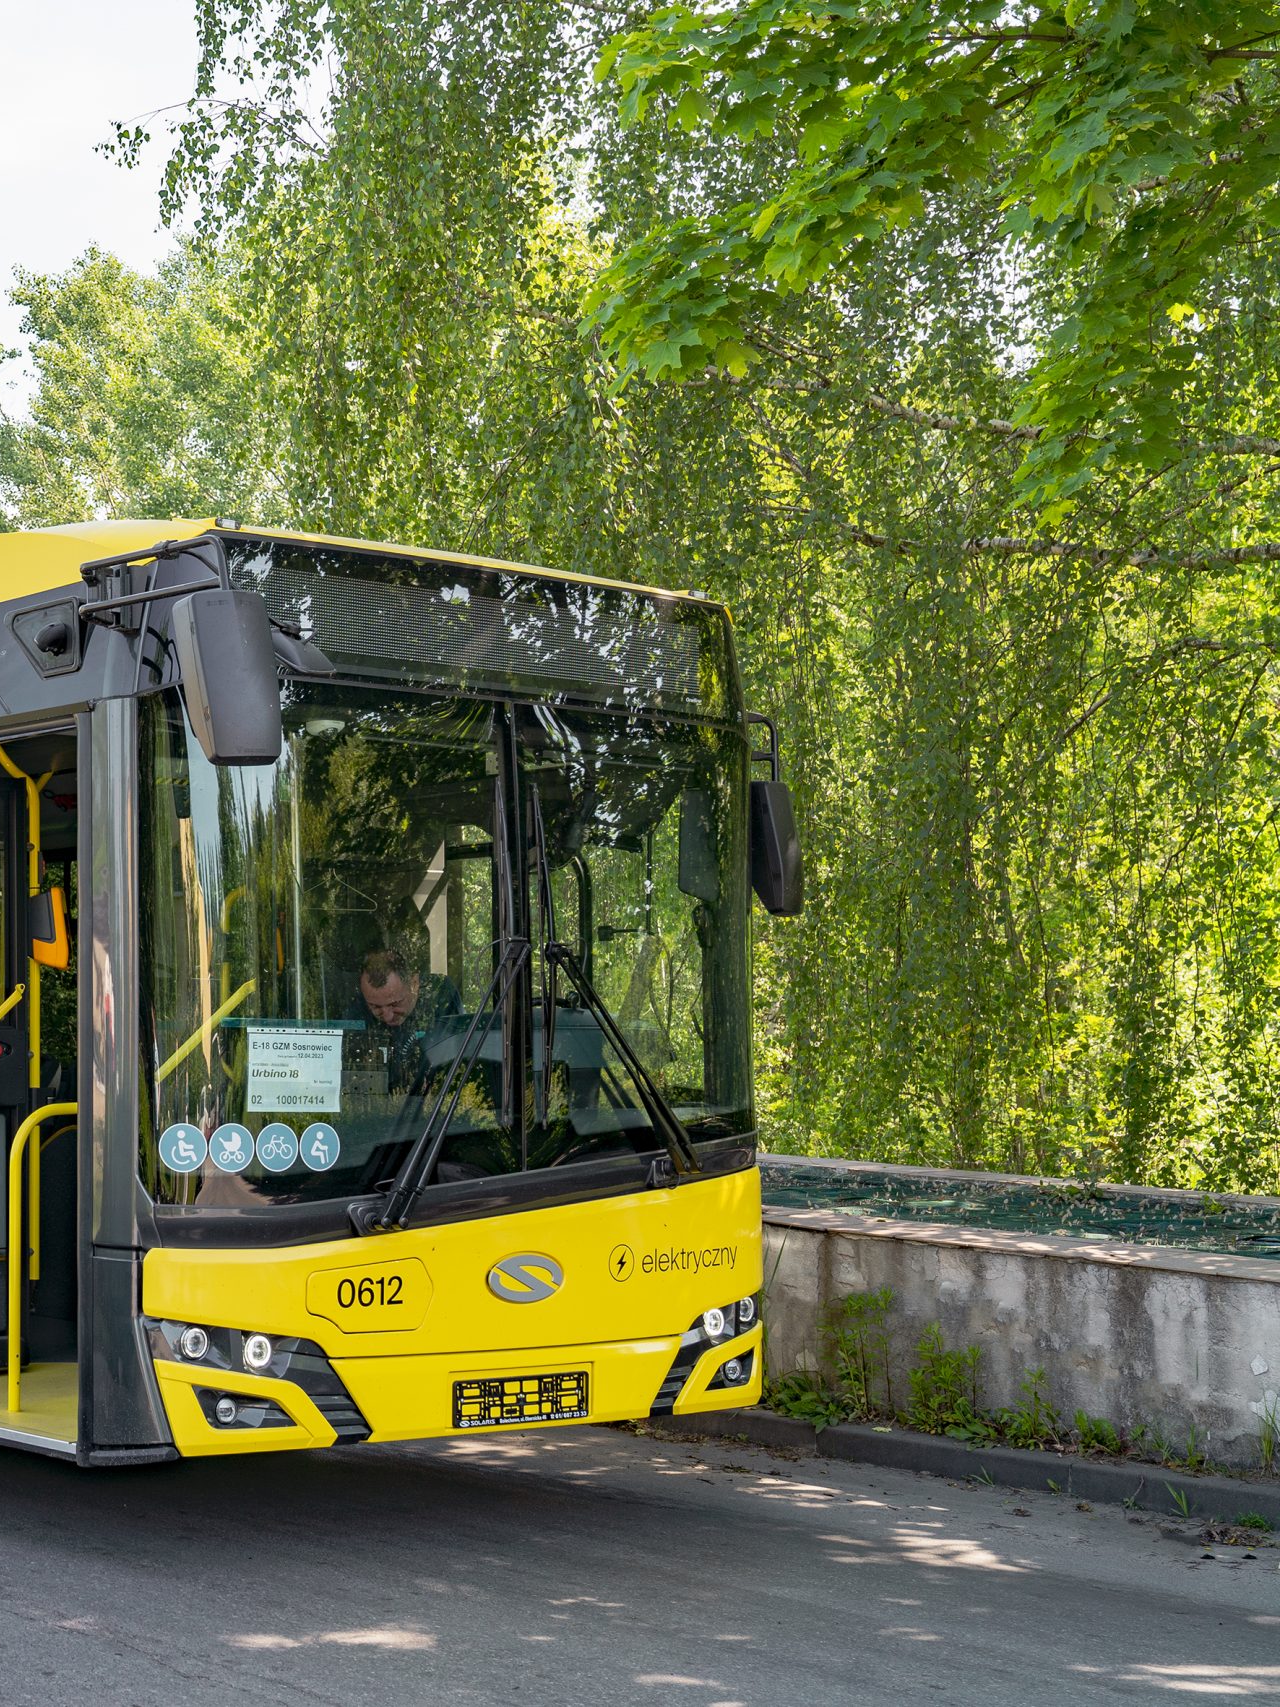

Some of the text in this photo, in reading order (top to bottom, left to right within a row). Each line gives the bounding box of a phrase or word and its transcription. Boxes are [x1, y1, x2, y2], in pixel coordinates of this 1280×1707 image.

[252, 1041, 333, 1052] E-18 GZM Sosnowiec
[252, 1068, 299, 1079] Urbino 18
[251, 1095, 325, 1105] 02 100017414
[641, 1245, 738, 1274] elektryczny
[337, 1275, 403, 1309] 0612
[470, 1418, 496, 1427] SOLARIS
